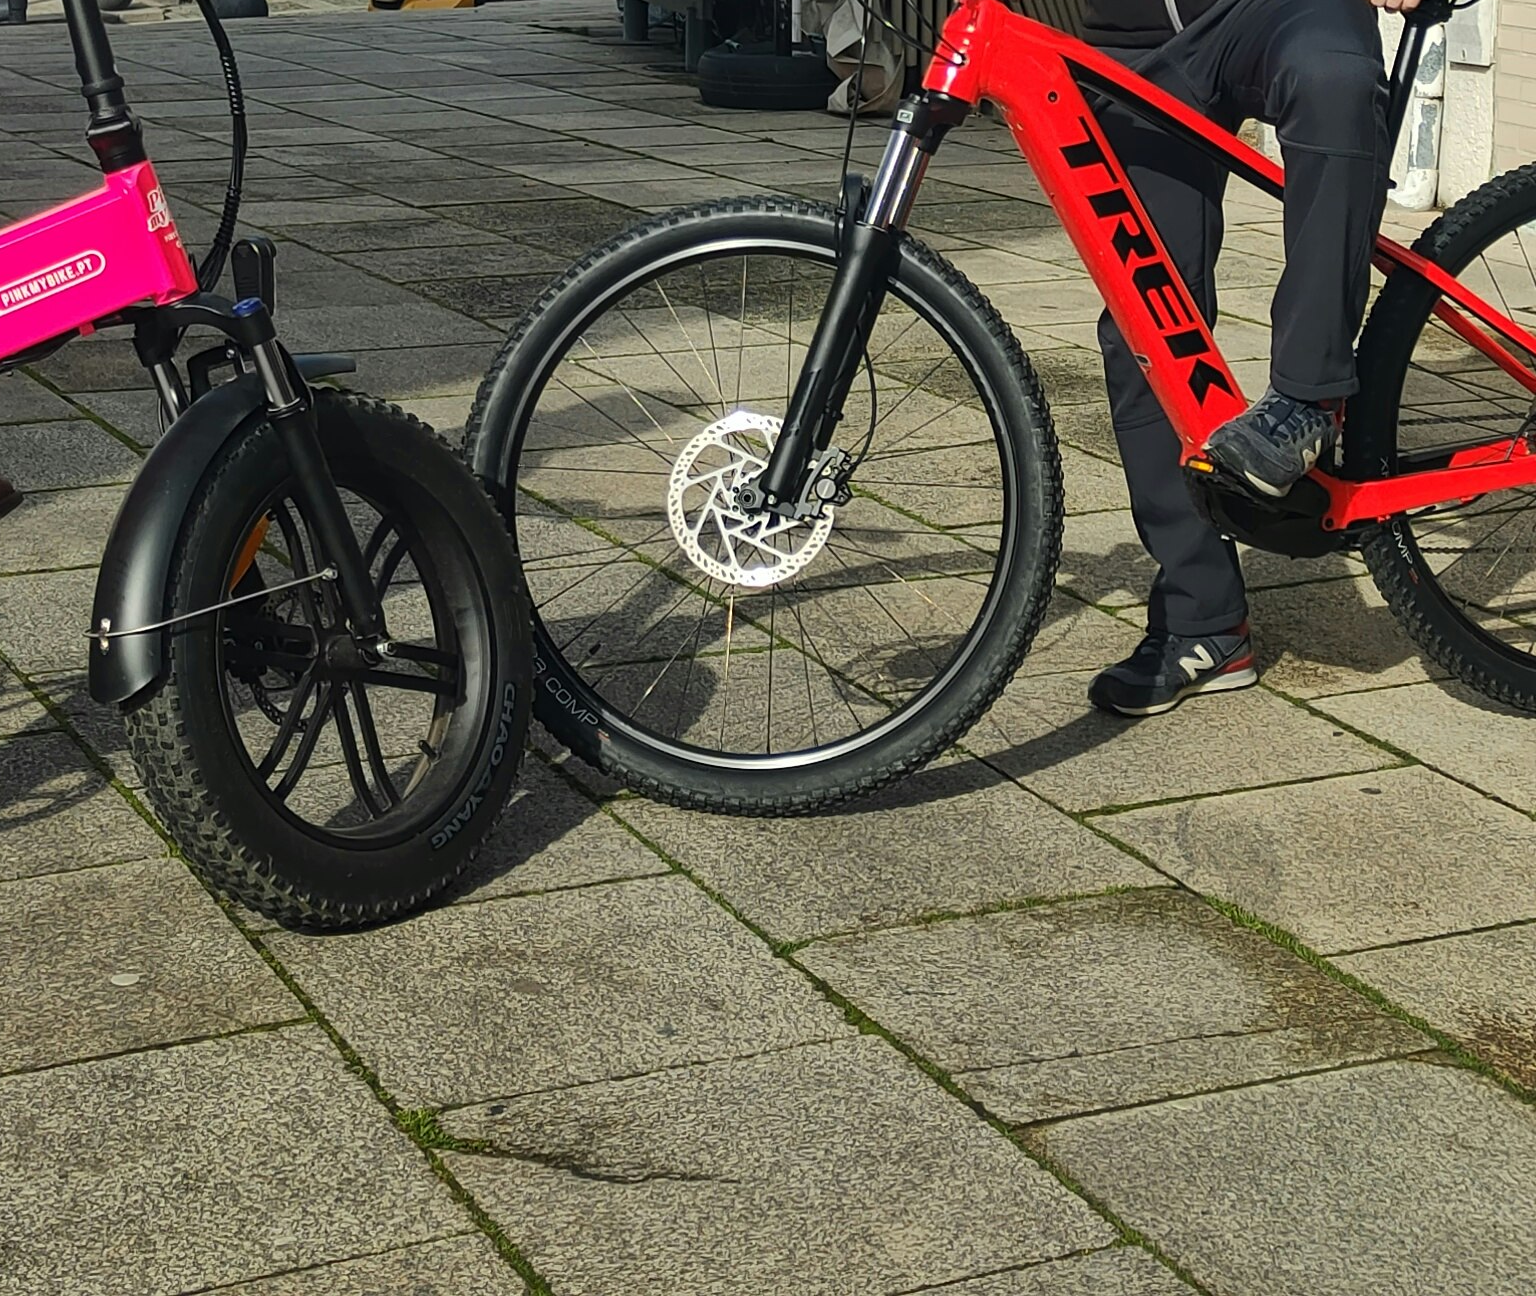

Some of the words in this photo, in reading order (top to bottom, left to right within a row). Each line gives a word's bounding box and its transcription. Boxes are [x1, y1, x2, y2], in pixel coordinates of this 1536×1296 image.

[0, 257, 94, 308] PINKMYBIKE.PT
[1058, 115, 1238, 408] TREK
[1391, 521, 1413, 565] OMP
[491, 683, 516, 767] CHAO
[545, 677, 599, 725] COMP
[431, 794, 484, 850] YANG
